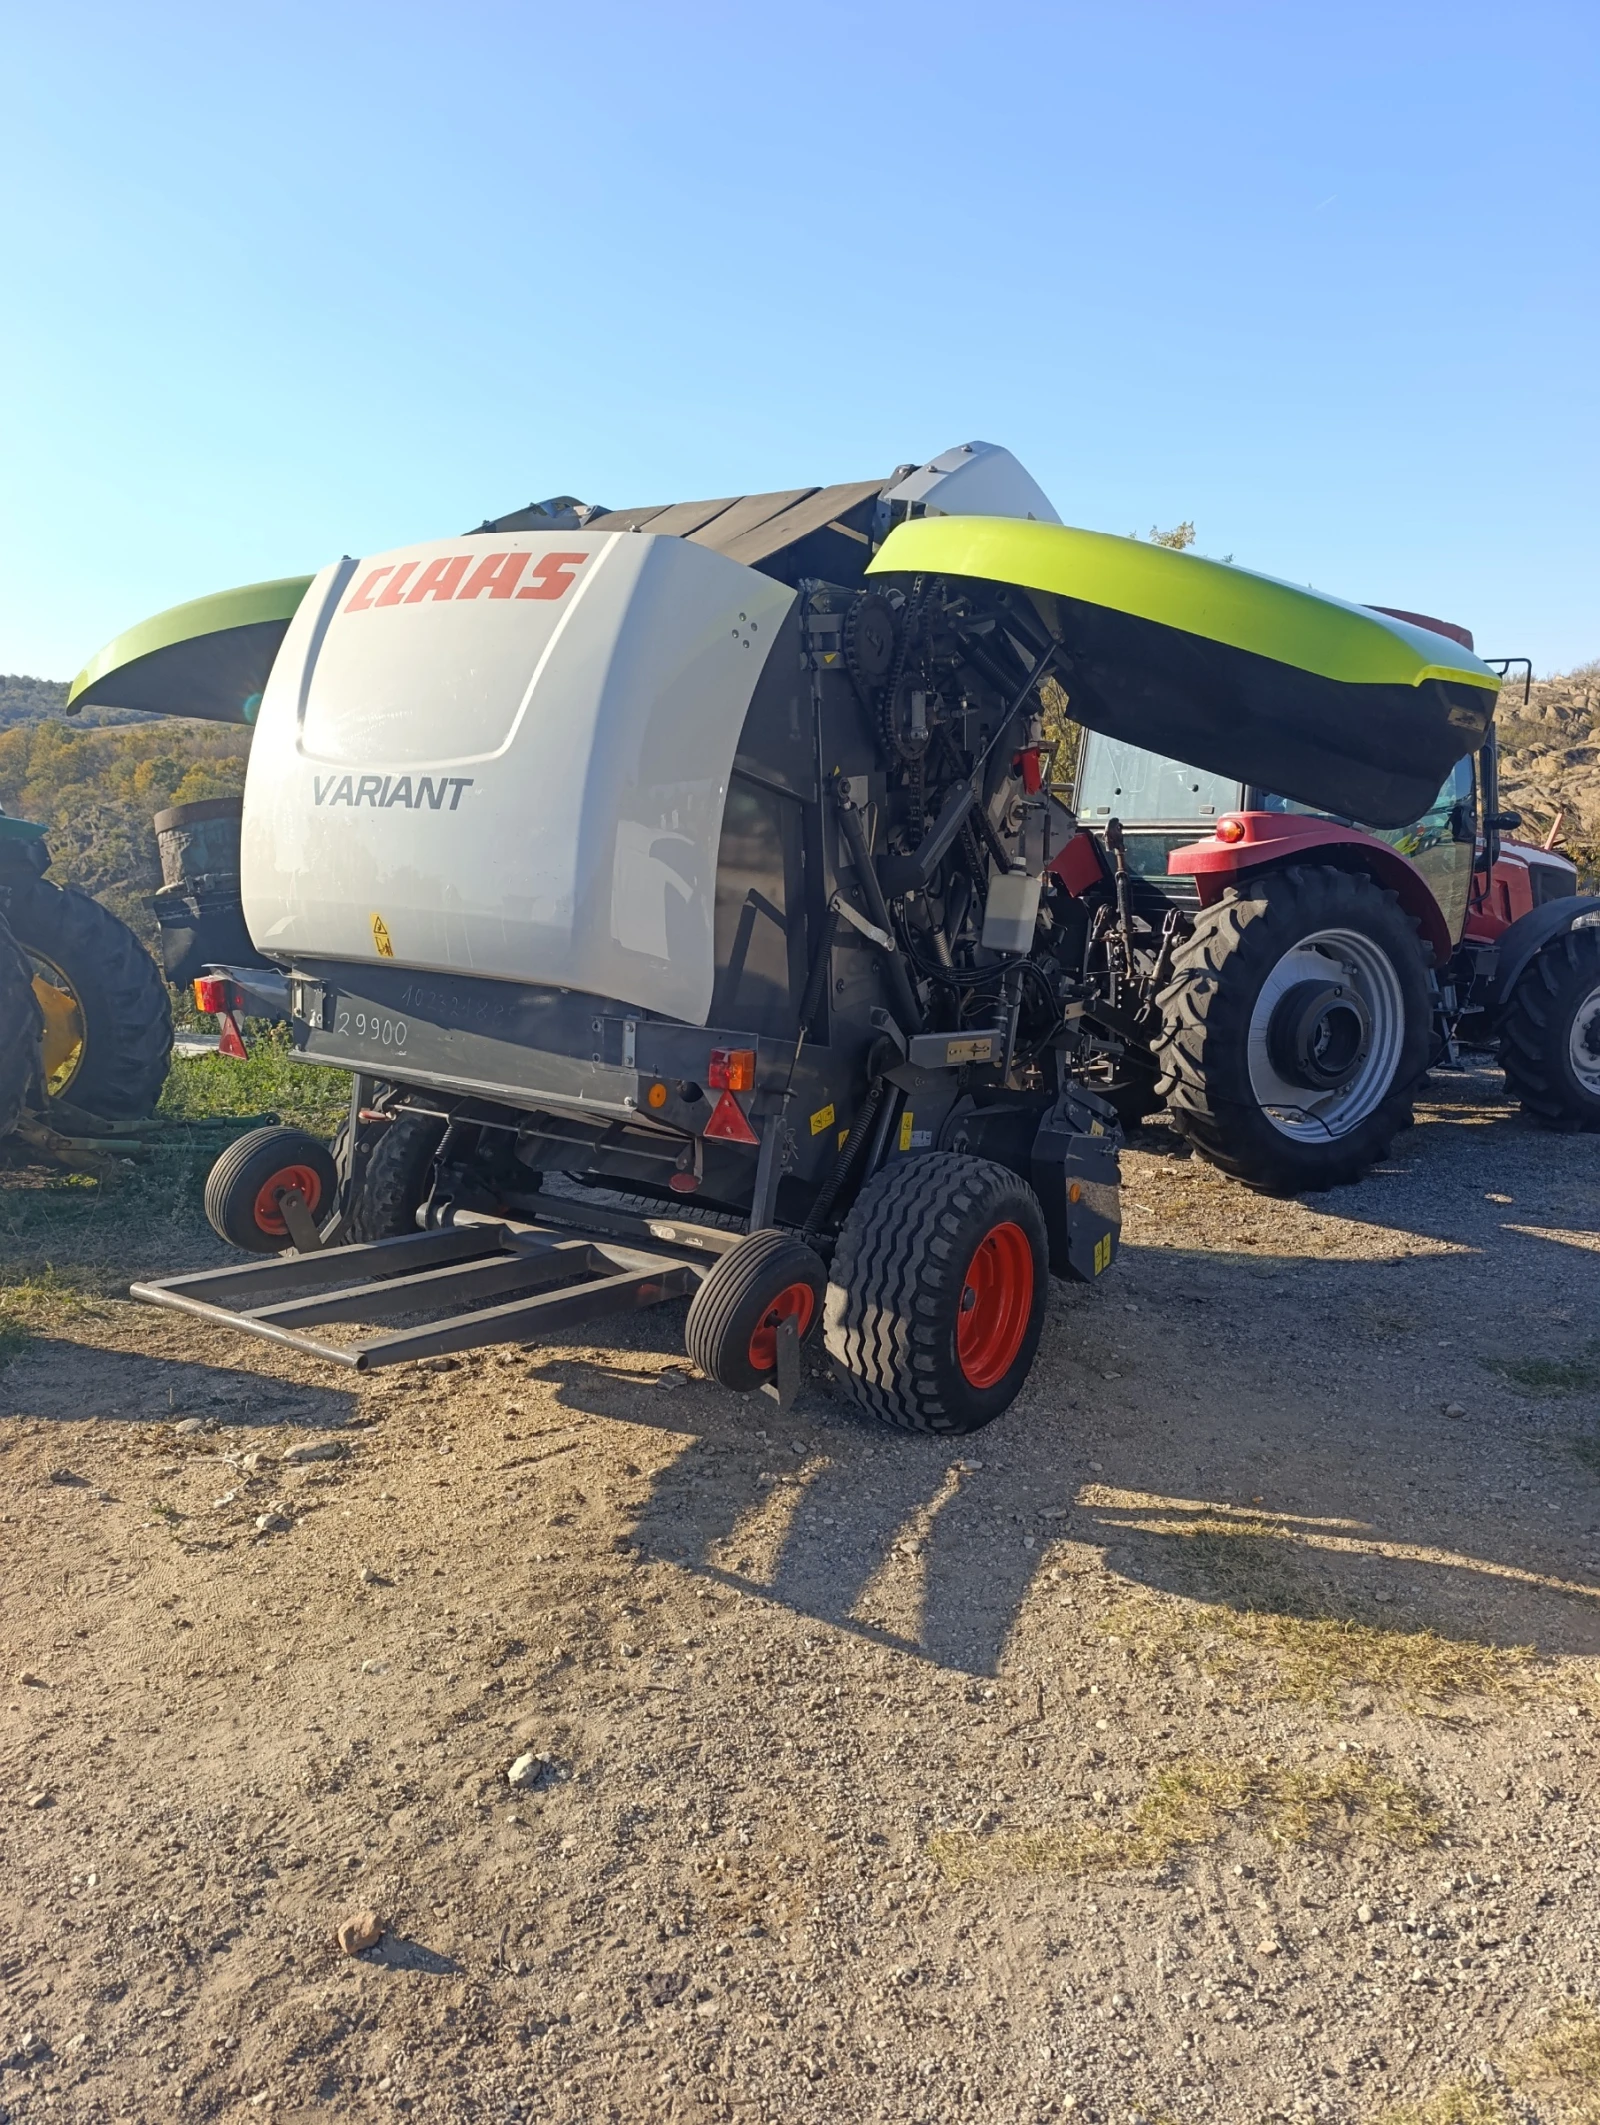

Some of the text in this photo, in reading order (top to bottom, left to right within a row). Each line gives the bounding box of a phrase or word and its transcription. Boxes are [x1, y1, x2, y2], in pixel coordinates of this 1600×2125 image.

[343, 552, 589, 613] CLAAS
[314, 775, 474, 811] VARIANT
[338, 1012, 407, 1045] 29900
